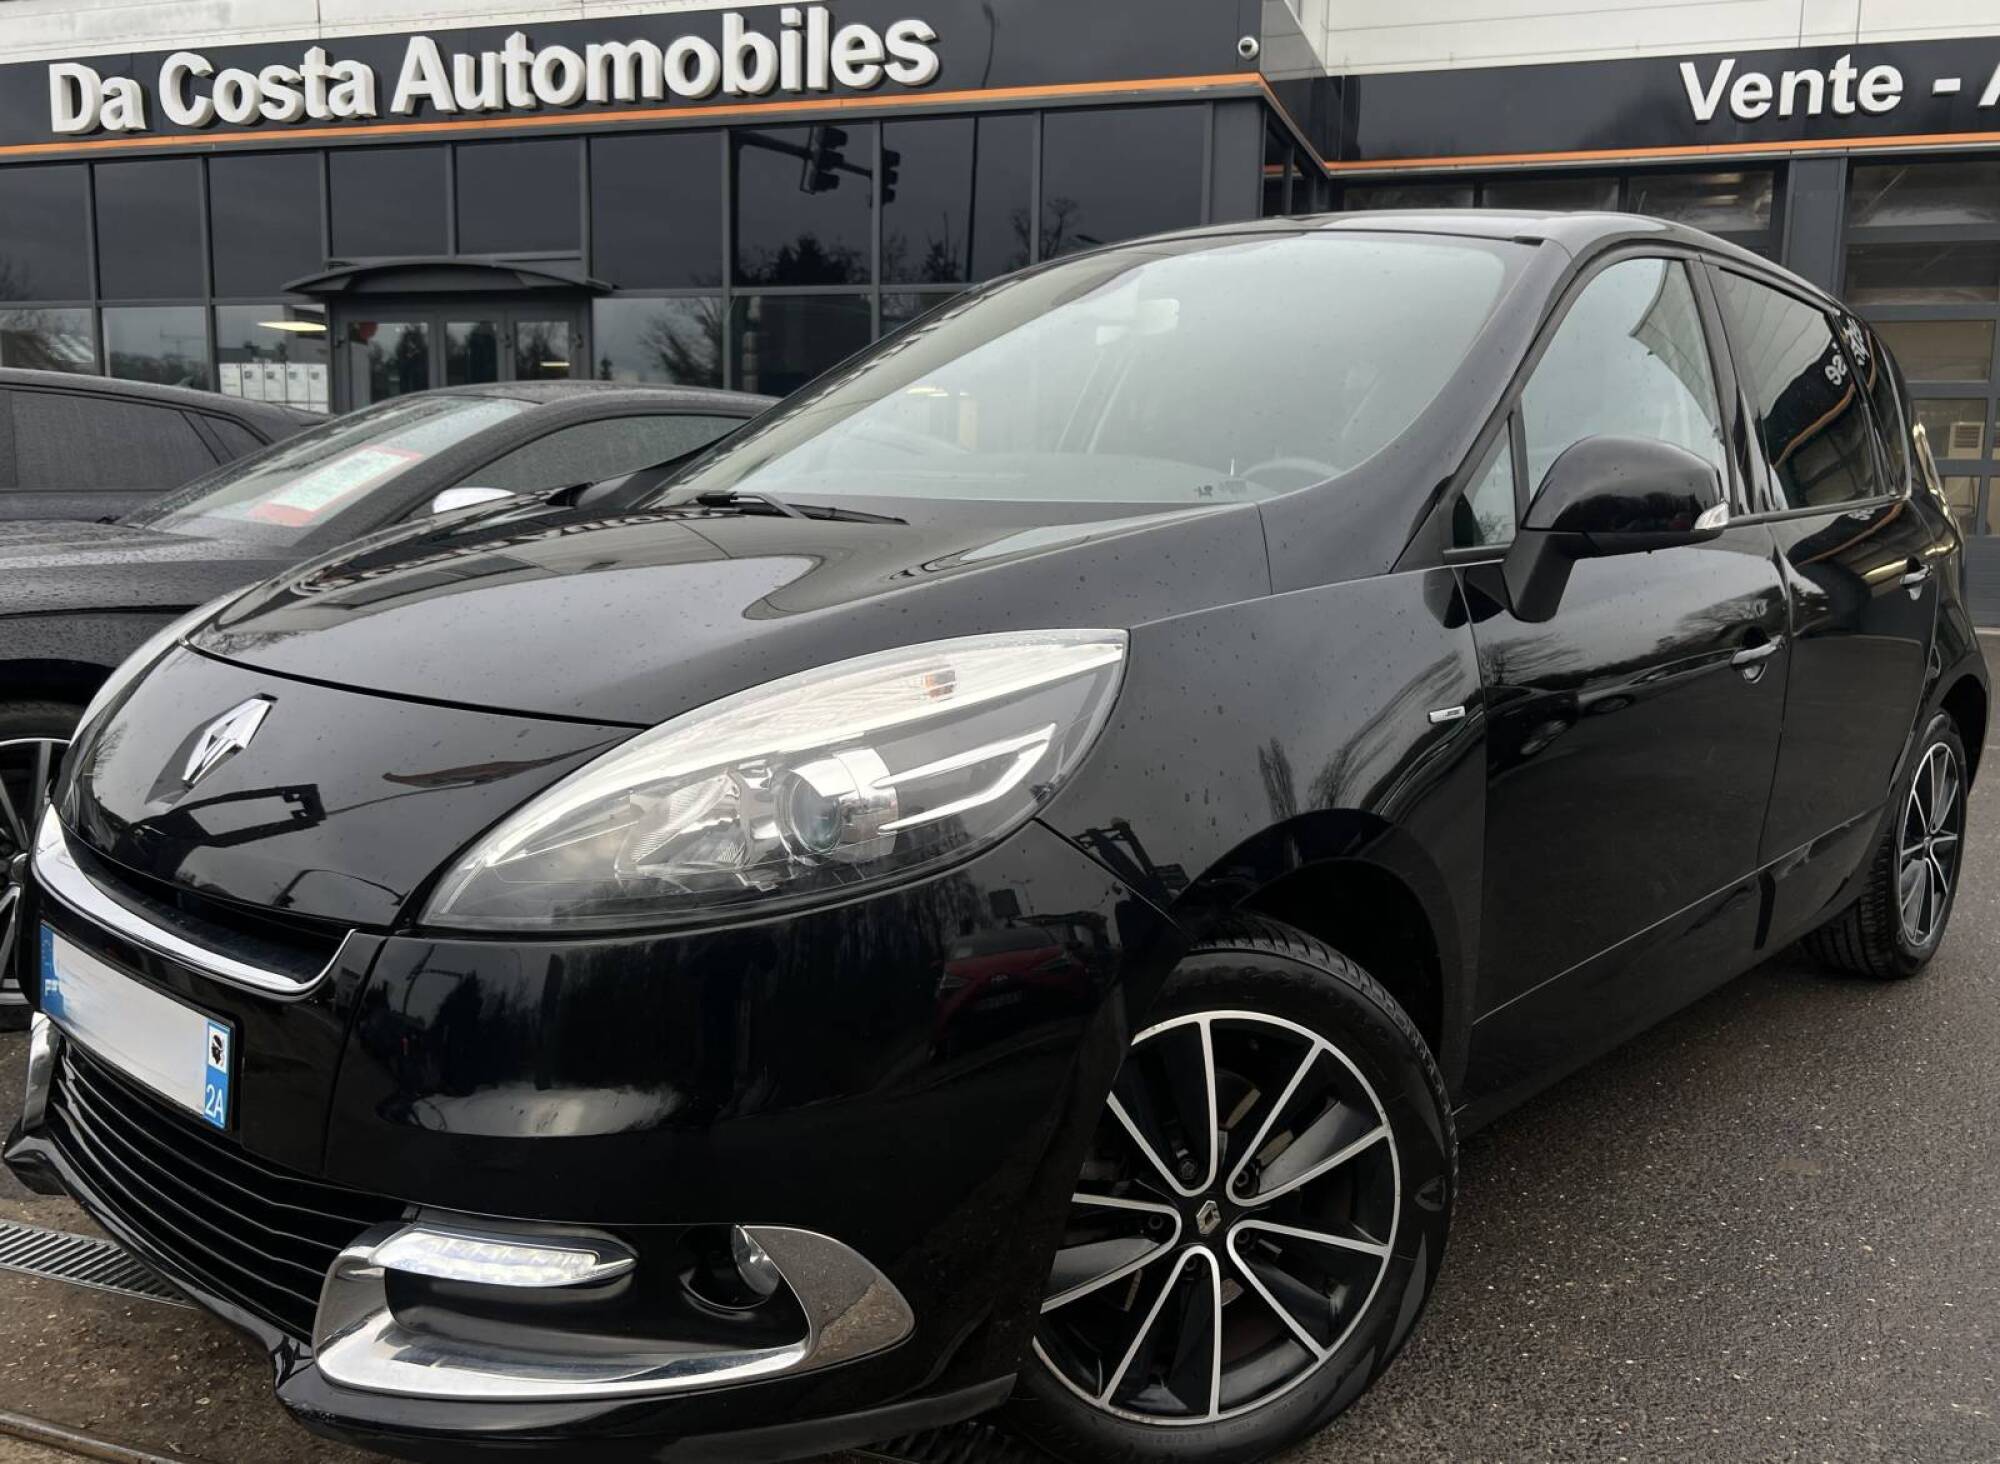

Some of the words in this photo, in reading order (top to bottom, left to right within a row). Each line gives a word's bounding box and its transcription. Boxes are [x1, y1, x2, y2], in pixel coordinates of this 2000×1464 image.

[49, 62, 147, 133] Da
[159, 45, 376, 127] Costa
[390, 6, 939, 114] Automobiles
[1679, 53, 1904, 121] Vente
[205, 1084, 225, 1125] 2A
